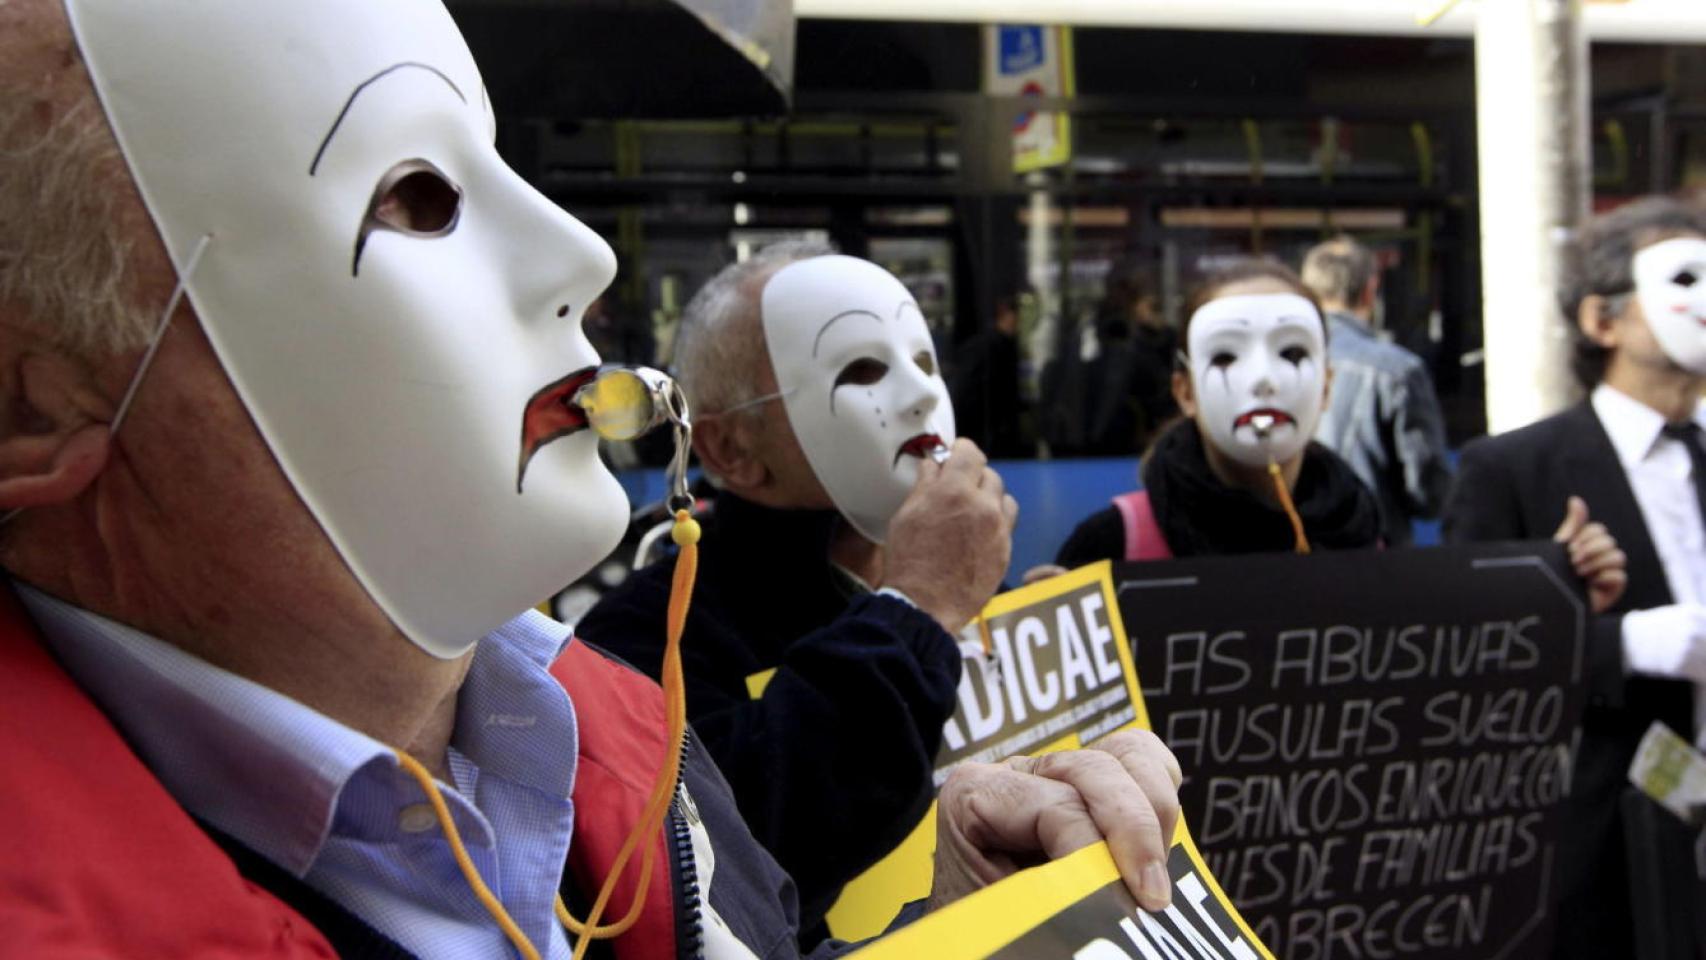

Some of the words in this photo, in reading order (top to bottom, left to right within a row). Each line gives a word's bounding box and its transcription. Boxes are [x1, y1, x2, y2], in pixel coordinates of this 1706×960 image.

[943, 592, 1122, 750] DICAE
[1272, 615, 1541, 688] ABUSIVAS
[1421, 685, 1564, 746] SUELO
[1201, 762, 1371, 845] BANCOS
[1374, 736, 1577, 822] ENRIQUECEN
[1287, 835, 1347, 907] DE
[1353, 811, 1544, 892] FAMILIAS
